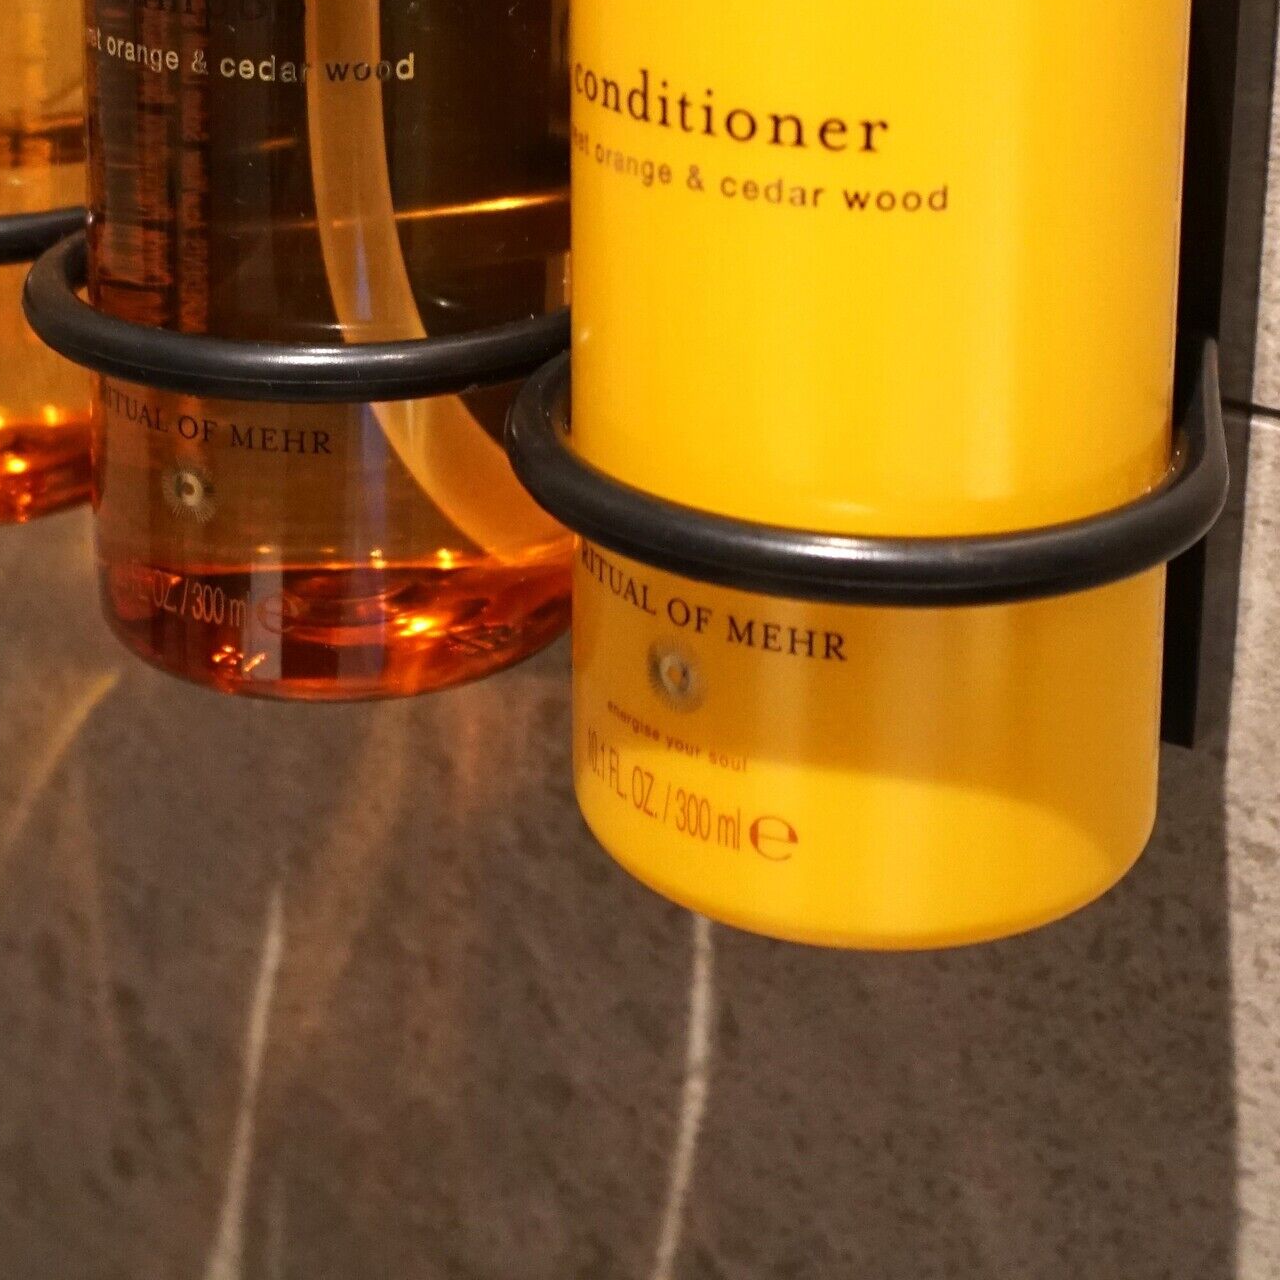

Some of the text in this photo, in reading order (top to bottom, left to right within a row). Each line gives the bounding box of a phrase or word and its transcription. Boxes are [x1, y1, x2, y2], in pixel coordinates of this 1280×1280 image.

[106, 35, 179, 73] orange
[191, 49, 209, 75] &
[219, 54, 312, 85] cedar
[325, 52, 416, 82] wood
[574, 62, 889, 153] conditioner
[594, 142, 672, 188] orange
[686, 164, 704, 192] &
[720, 175, 825, 208] cedar
[843, 183, 949, 213] wood
[178, 415, 218, 442] OF
[230, 423, 333, 455] MEHR
[191, 581, 225, 625] 300
[666, 597, 713, 634] OF
[727, 615, 847, 662] MEHR
[666, 735, 702, 760] your
[708, 750, 748, 773] soul
[675, 788, 712, 842] 300
[717, 807, 741, 851] ml
